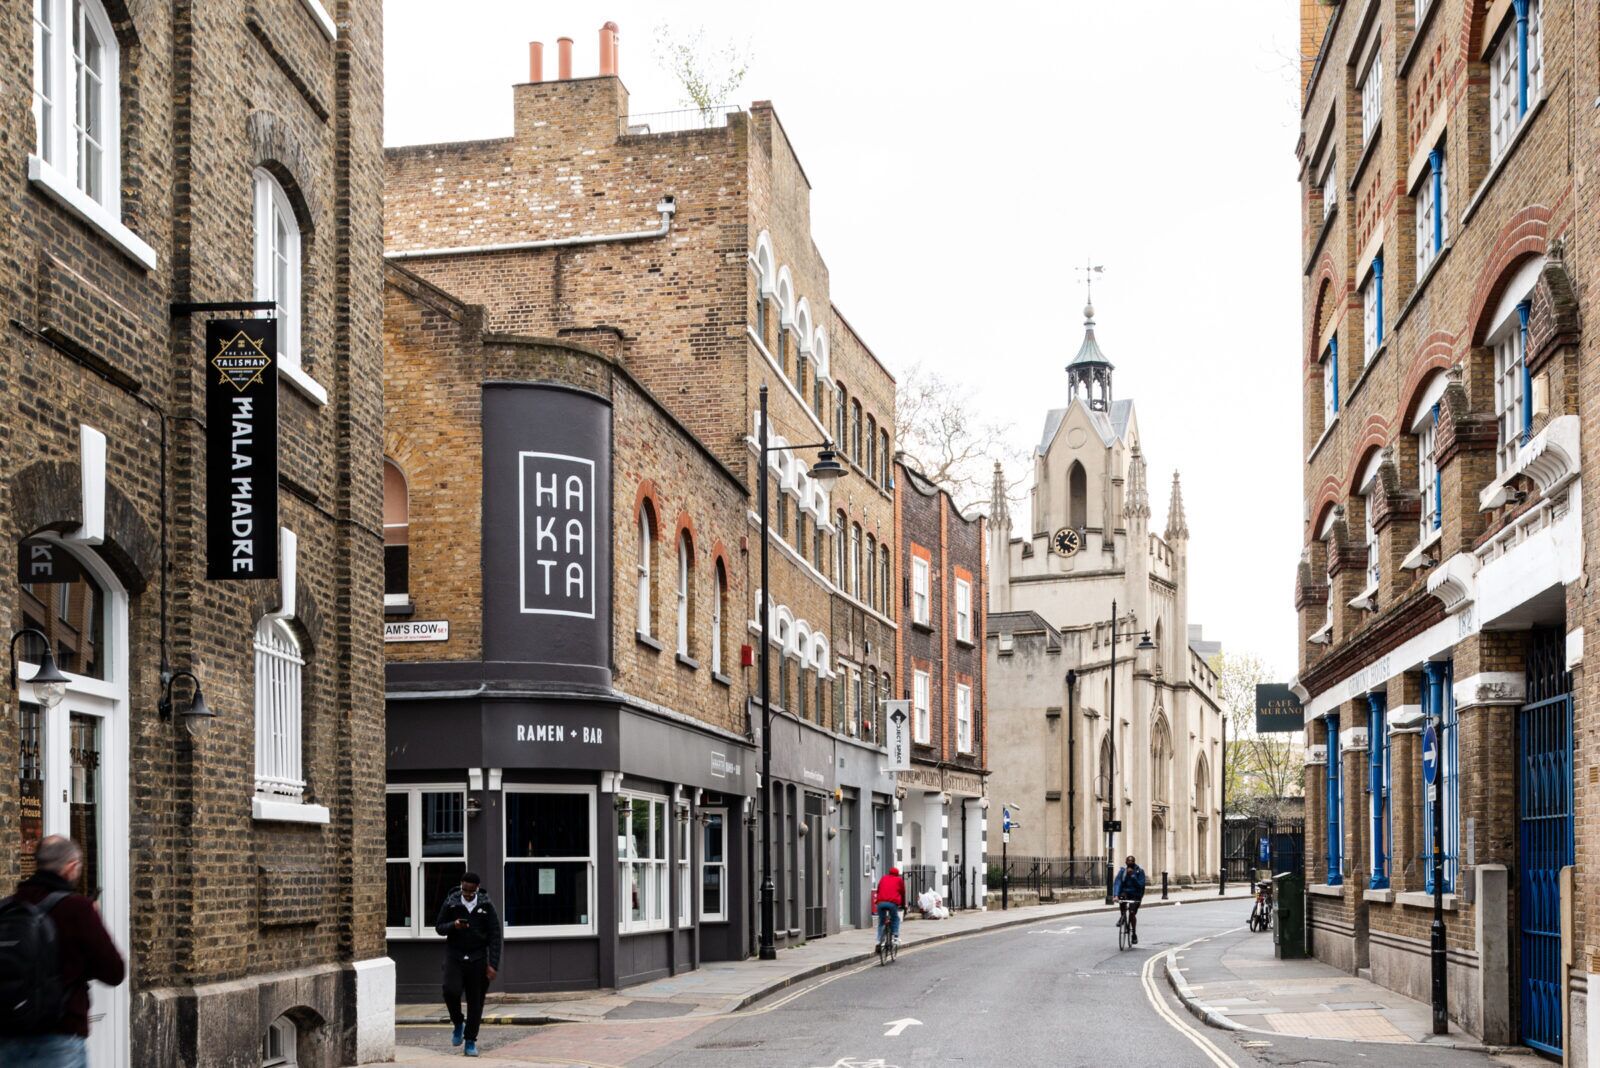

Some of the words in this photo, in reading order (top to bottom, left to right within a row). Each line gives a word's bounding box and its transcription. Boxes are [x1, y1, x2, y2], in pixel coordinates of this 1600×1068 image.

[217, 359, 265, 367] TALISMAN
[232, 397, 253, 470] MALA
[536, 471, 584, 512] HA
[231, 477, 254, 573] MADRE
[536, 515, 584, 555] KA
[537, 559, 584, 599] TA
[413, 623, 438, 634] ROW
[1370, 656, 1391, 684] HOUSE
[1260, 707, 1302, 715] MURANO
[517, 724, 564, 742] RAMEN
[583, 726, 603, 744] BAR
[949, 775, 982, 797] SETTLEMENT
[24, 808, 41, 818] House
